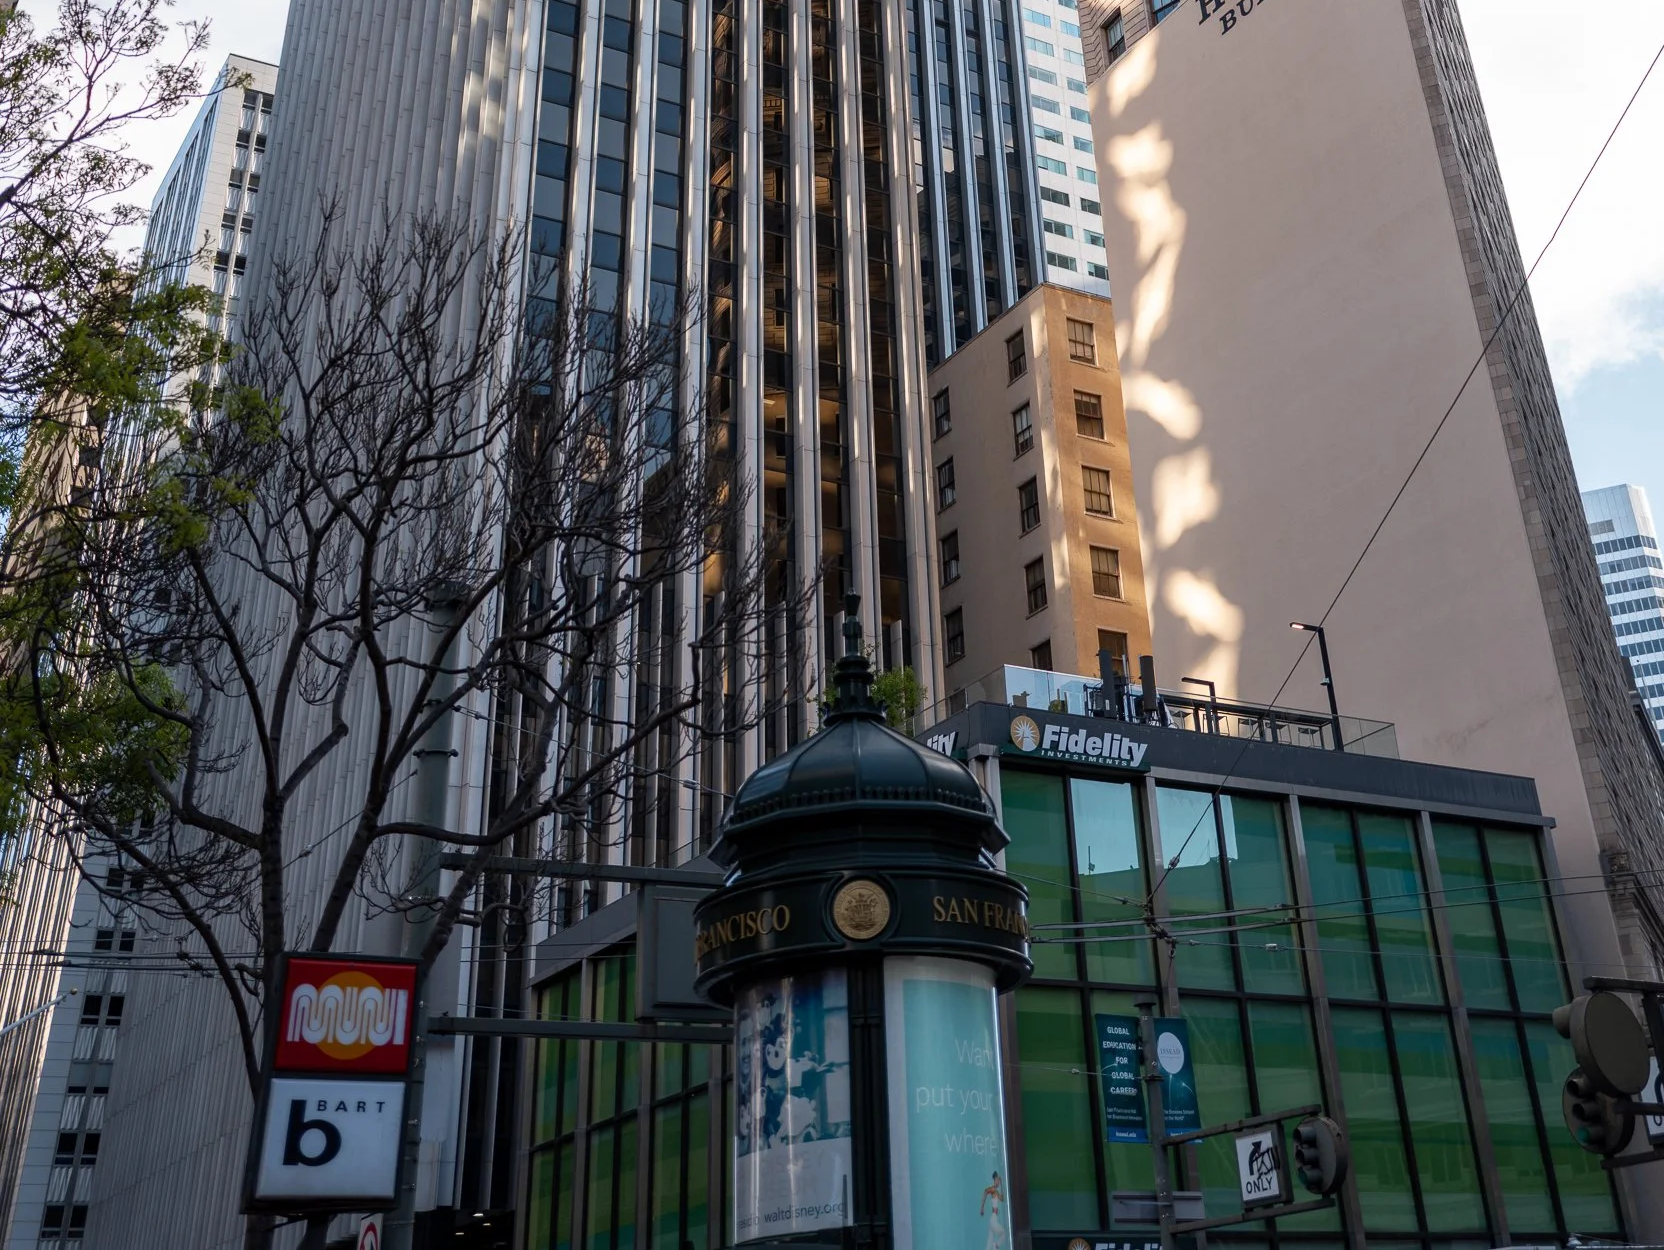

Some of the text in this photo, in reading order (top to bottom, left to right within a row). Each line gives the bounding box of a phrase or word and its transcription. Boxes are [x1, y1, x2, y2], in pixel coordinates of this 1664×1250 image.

[926, 731, 956, 757] lity
[1042, 724, 1148, 767] Fidelity
[1041, 750, 1128, 767] INVESTMENTS
[933, 896, 978, 924] SAN
[1107, 1026, 1130, 1036] GLOBAL
[1102, 1041, 1137, 1051] EDUCATION
[1115, 1056, 1129, 1065] FOR
[1111, 1071, 1135, 1081] GLOBAL
[316, 1100, 387, 1114] BART
[915, 1083, 993, 1115] put your
[282, 1099, 342, 1167] b
[945, 1128, 998, 1156] where
[1246, 1176, 1273, 1194] ONLY
